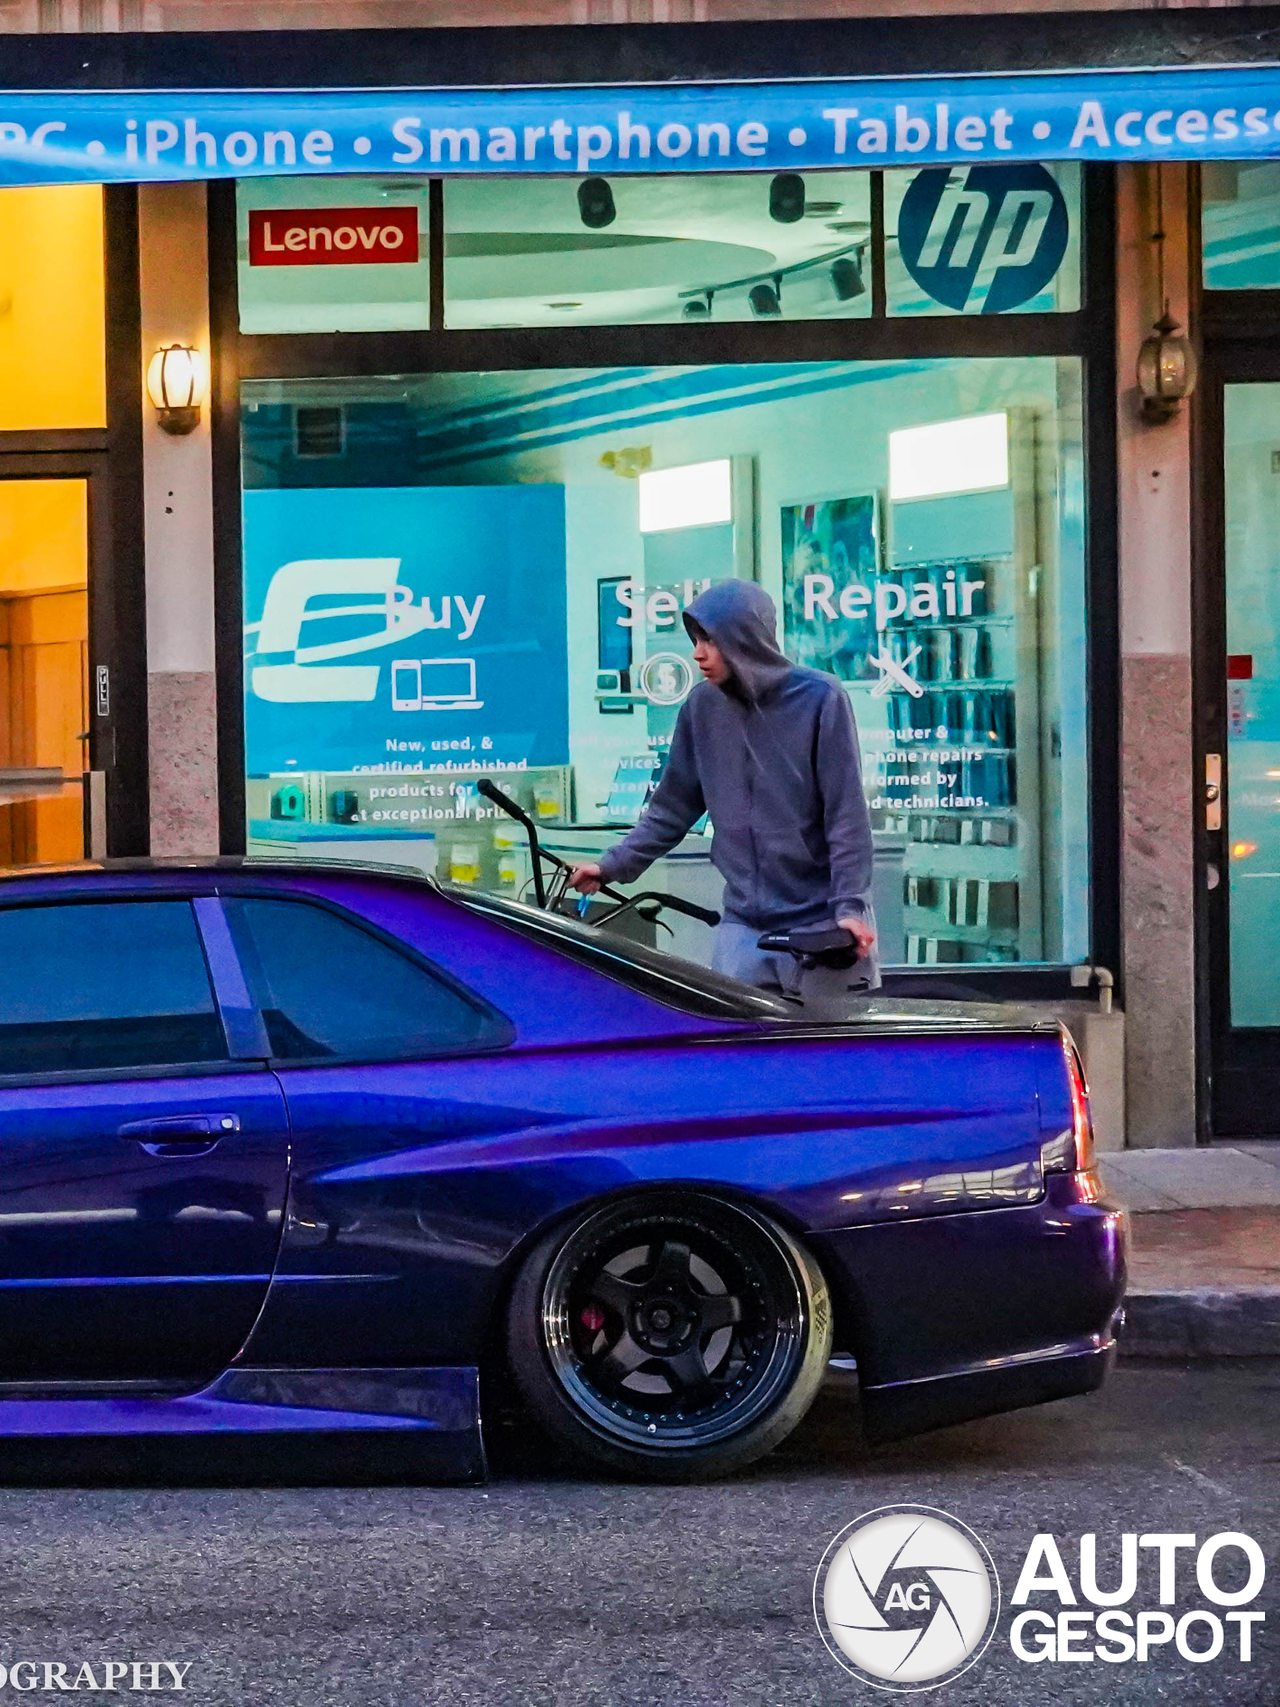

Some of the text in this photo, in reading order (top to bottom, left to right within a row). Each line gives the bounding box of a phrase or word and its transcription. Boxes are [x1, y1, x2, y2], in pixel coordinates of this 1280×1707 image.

[125, 118, 334, 166] iPhone
[392, 111, 769, 172] Smartphone
[823, 103, 1014, 155] Tablet
[263, 221, 404, 252] Lenovo
[916, 163, 1052, 312] hp
[803, 570, 985, 631] Repair
[385, 585, 486, 641] Buy
[935, 725, 948, 739] &
[386, 736, 493, 753] New, used, &
[922, 747, 983, 765] repairs
[352, 758, 528, 773] certified refurbished
[937, 770, 957, 788] by
[370, 782, 444, 800] products
[449, 782, 473, 796] for
[887, 794, 989, 809] technicians.
[372, 806, 470, 822] exceptional
